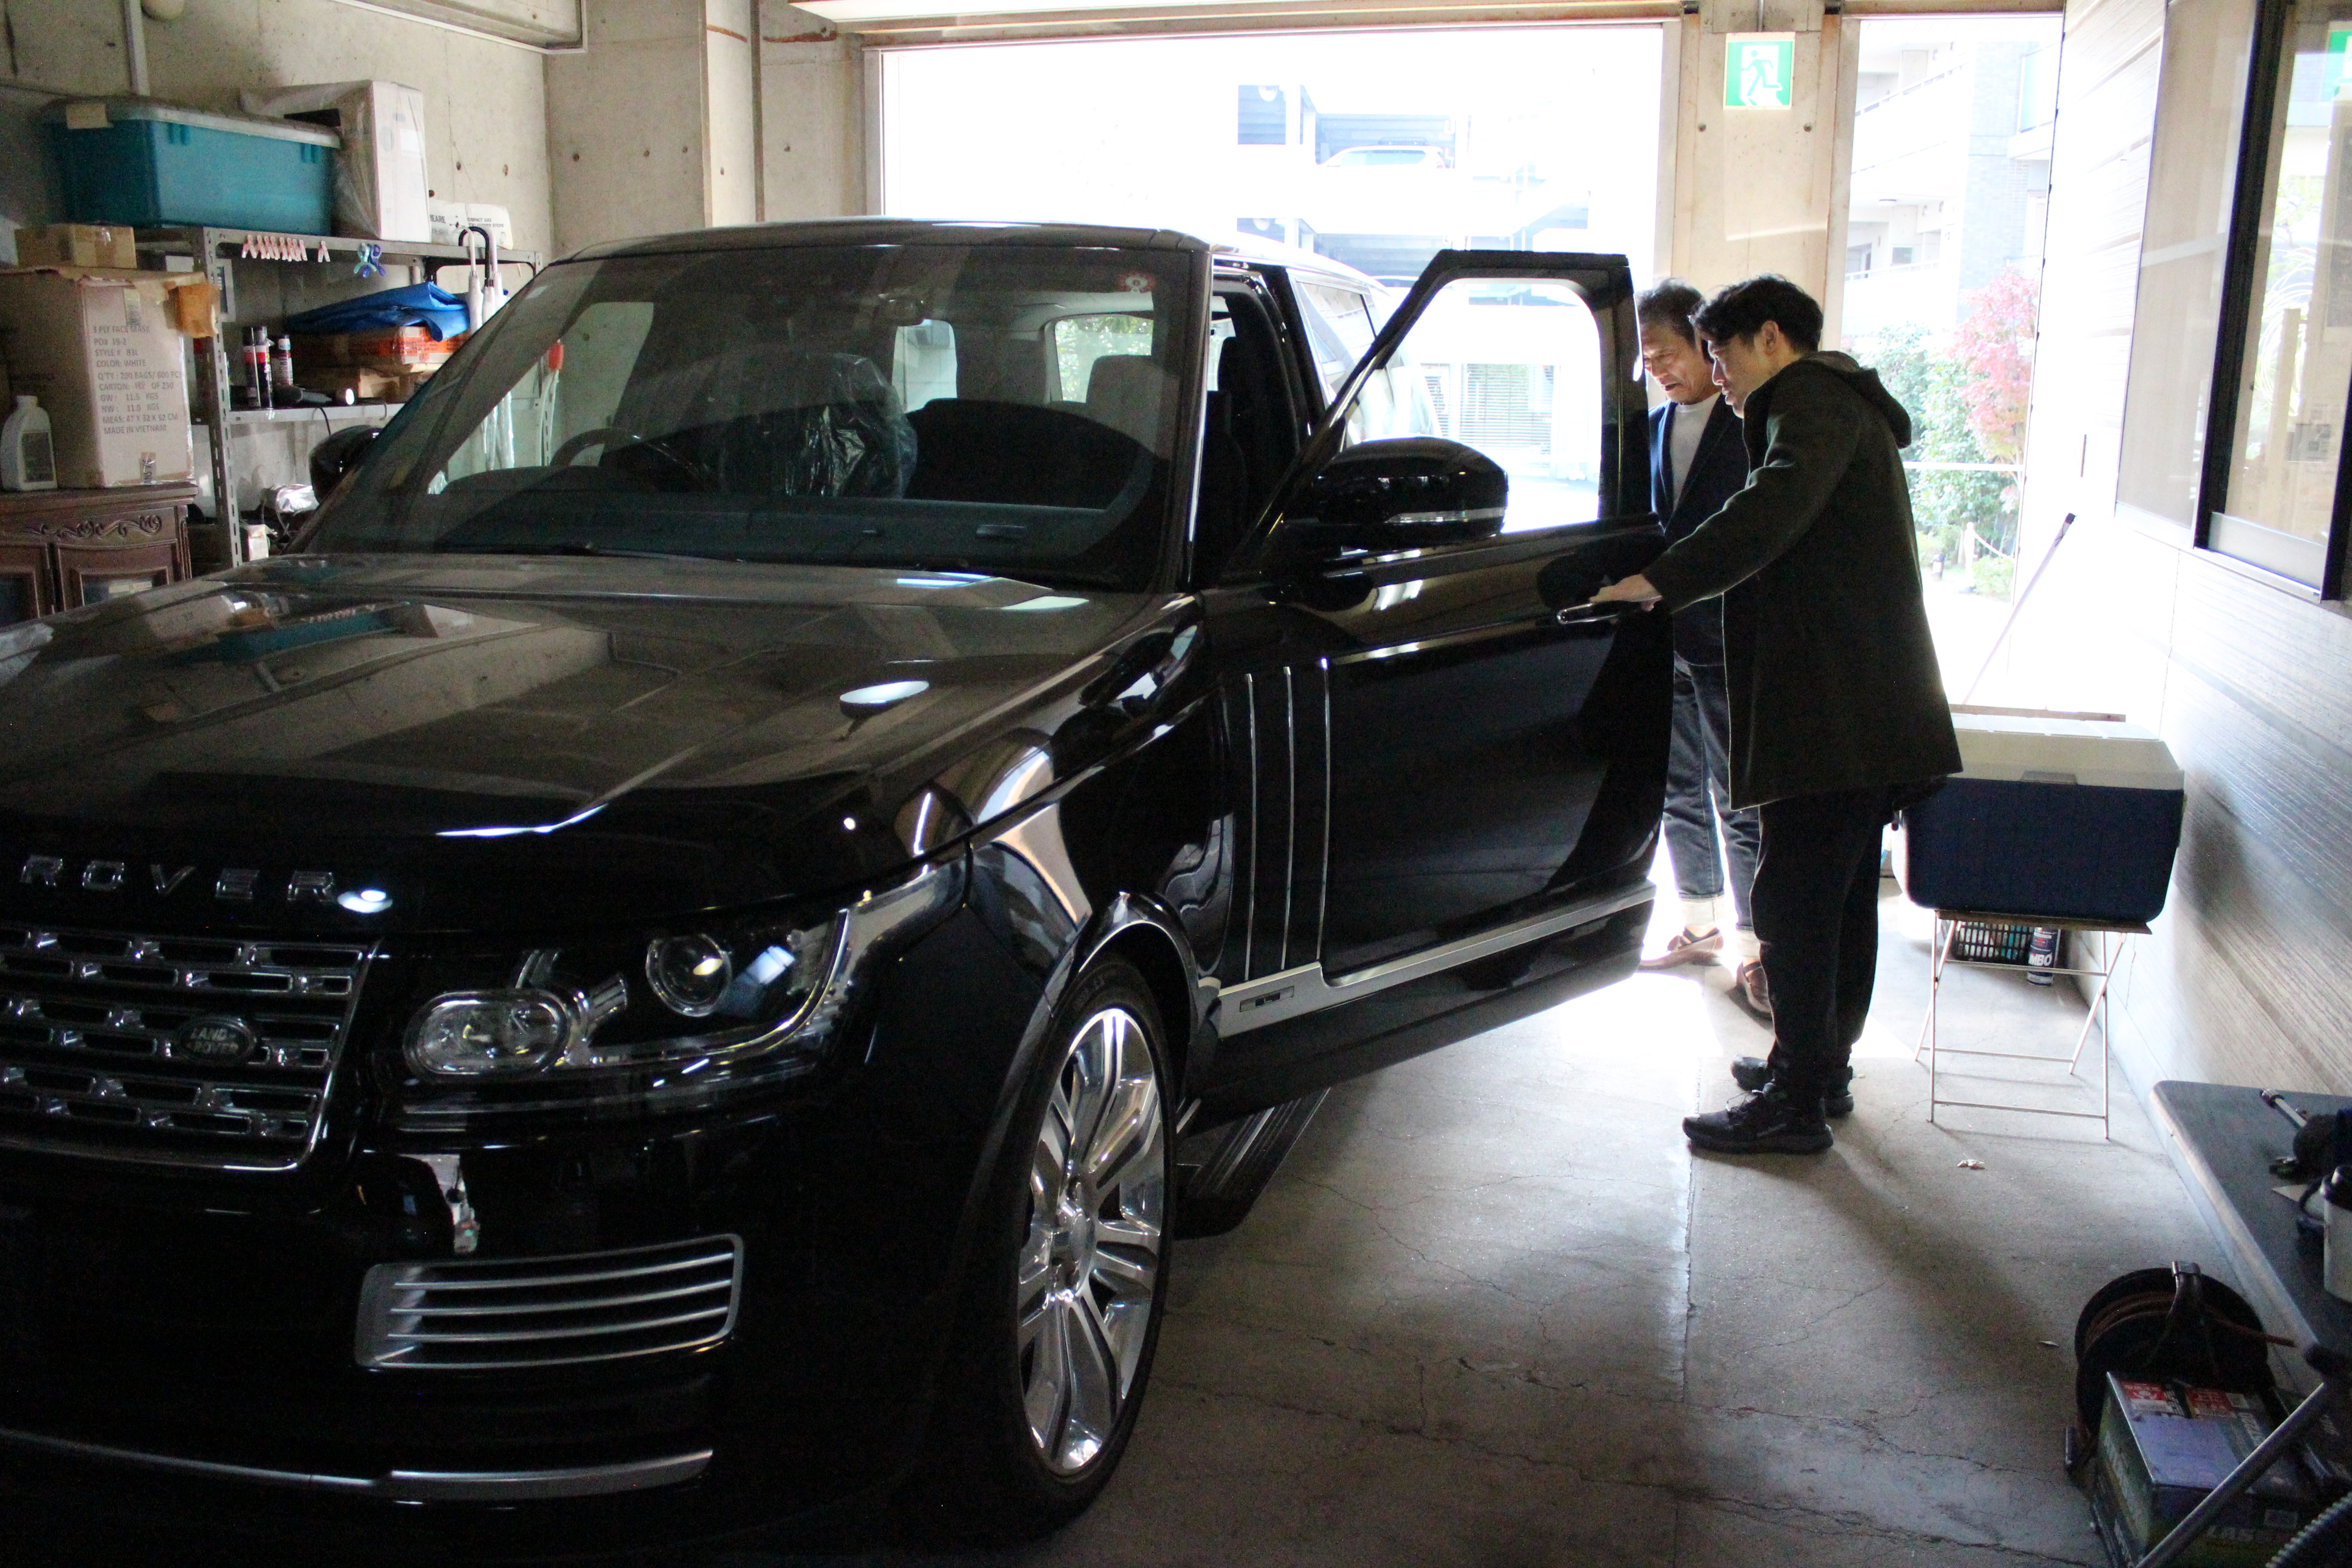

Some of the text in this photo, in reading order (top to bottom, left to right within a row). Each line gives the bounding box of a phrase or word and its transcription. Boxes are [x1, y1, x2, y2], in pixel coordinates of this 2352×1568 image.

[135, 425, 167, 434] VIETNAM
[20, 855, 335, 902] ROVER
[190, 1027, 228, 1042] LAND
[194, 1041, 239, 1054] ROVER
